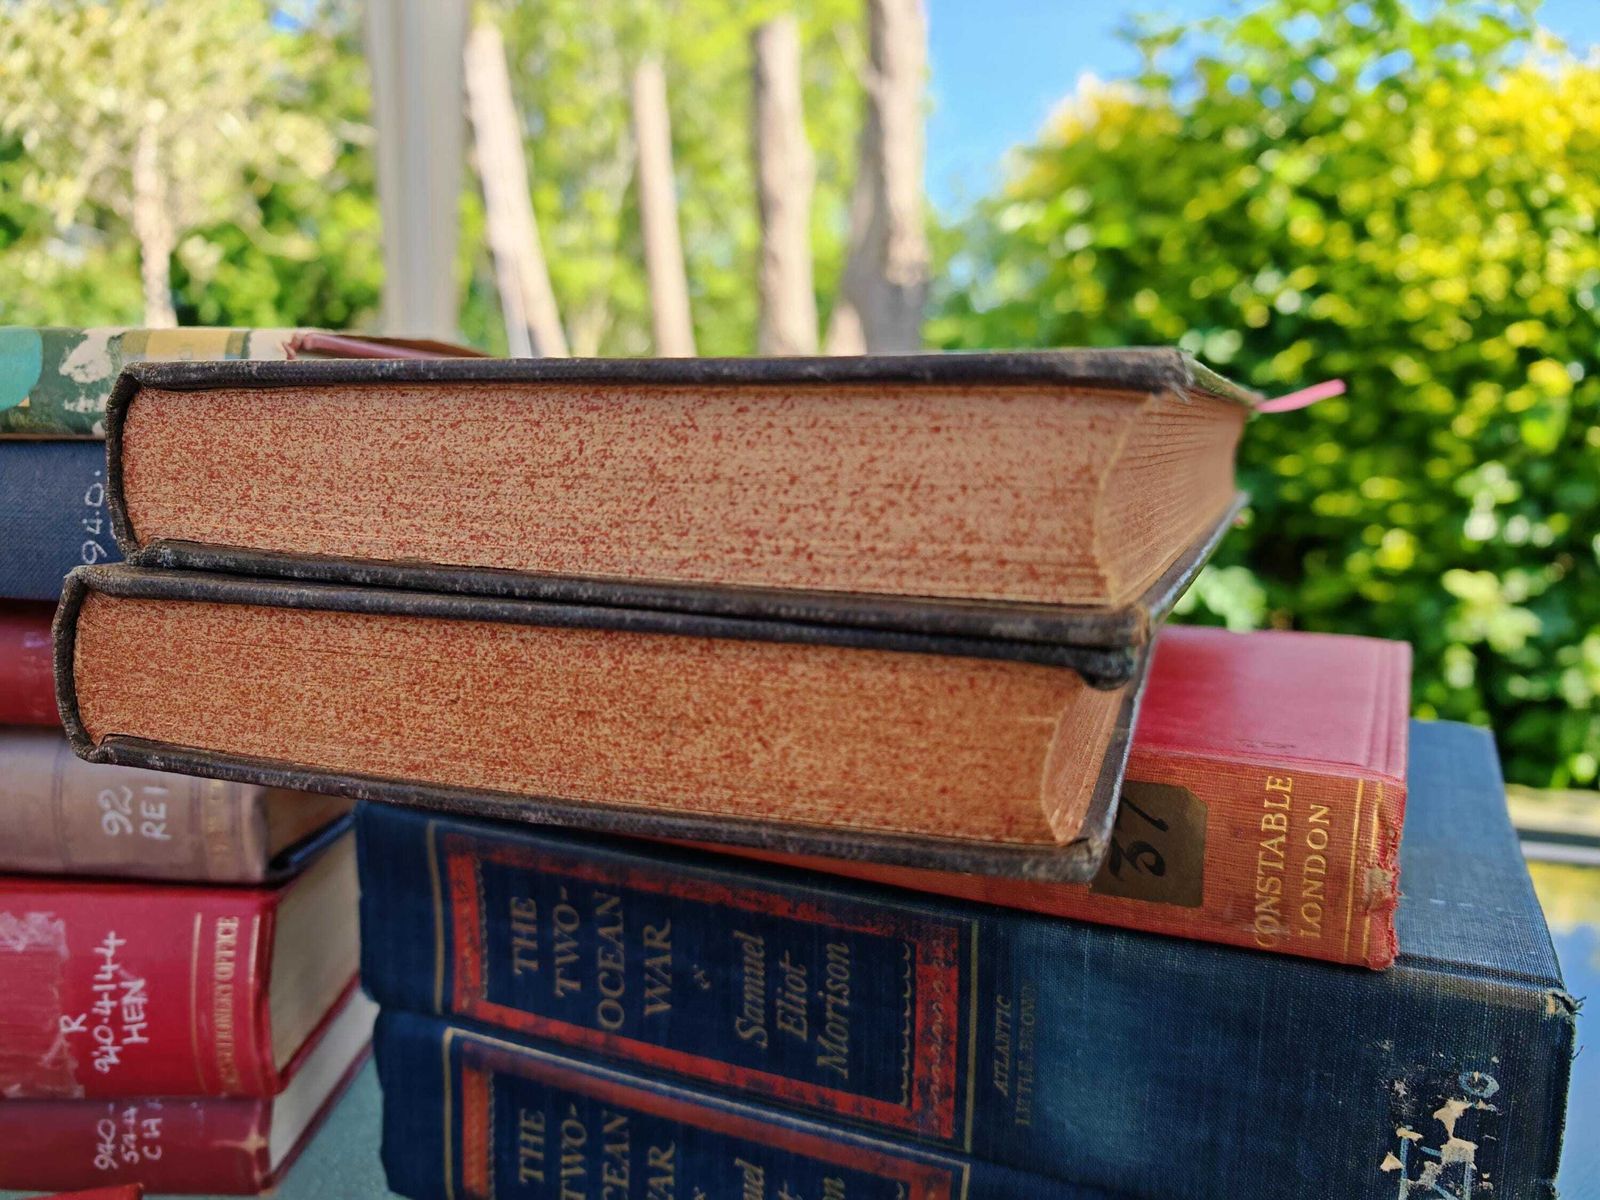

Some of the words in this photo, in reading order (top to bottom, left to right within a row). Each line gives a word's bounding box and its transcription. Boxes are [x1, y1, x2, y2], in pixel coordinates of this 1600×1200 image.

[101, 786, 134, 837] 92
[140, 785, 171, 840] REI
[1254, 775, 1293, 948] CONSTABLE
[1300, 803, 1330, 938] LONDON
[510, 896, 540, 977] THE
[552, 886, 583, 998] TWO-
[595, 891, 625, 1030] OCEAN
[643, 918, 673, 1017] WAR
[60, 1012, 88, 1034] R
[122, 977, 149, 1045] HEN
[734, 930, 768, 1050] Samuel
[776, 950, 809, 1043] Eliot
[816, 942, 850, 1080] Morison
[992, 994, 1012, 1097] ATLANTIC
[519, 1107, 545, 1185] THE
[560, 1102, 587, 1200] TWO-
